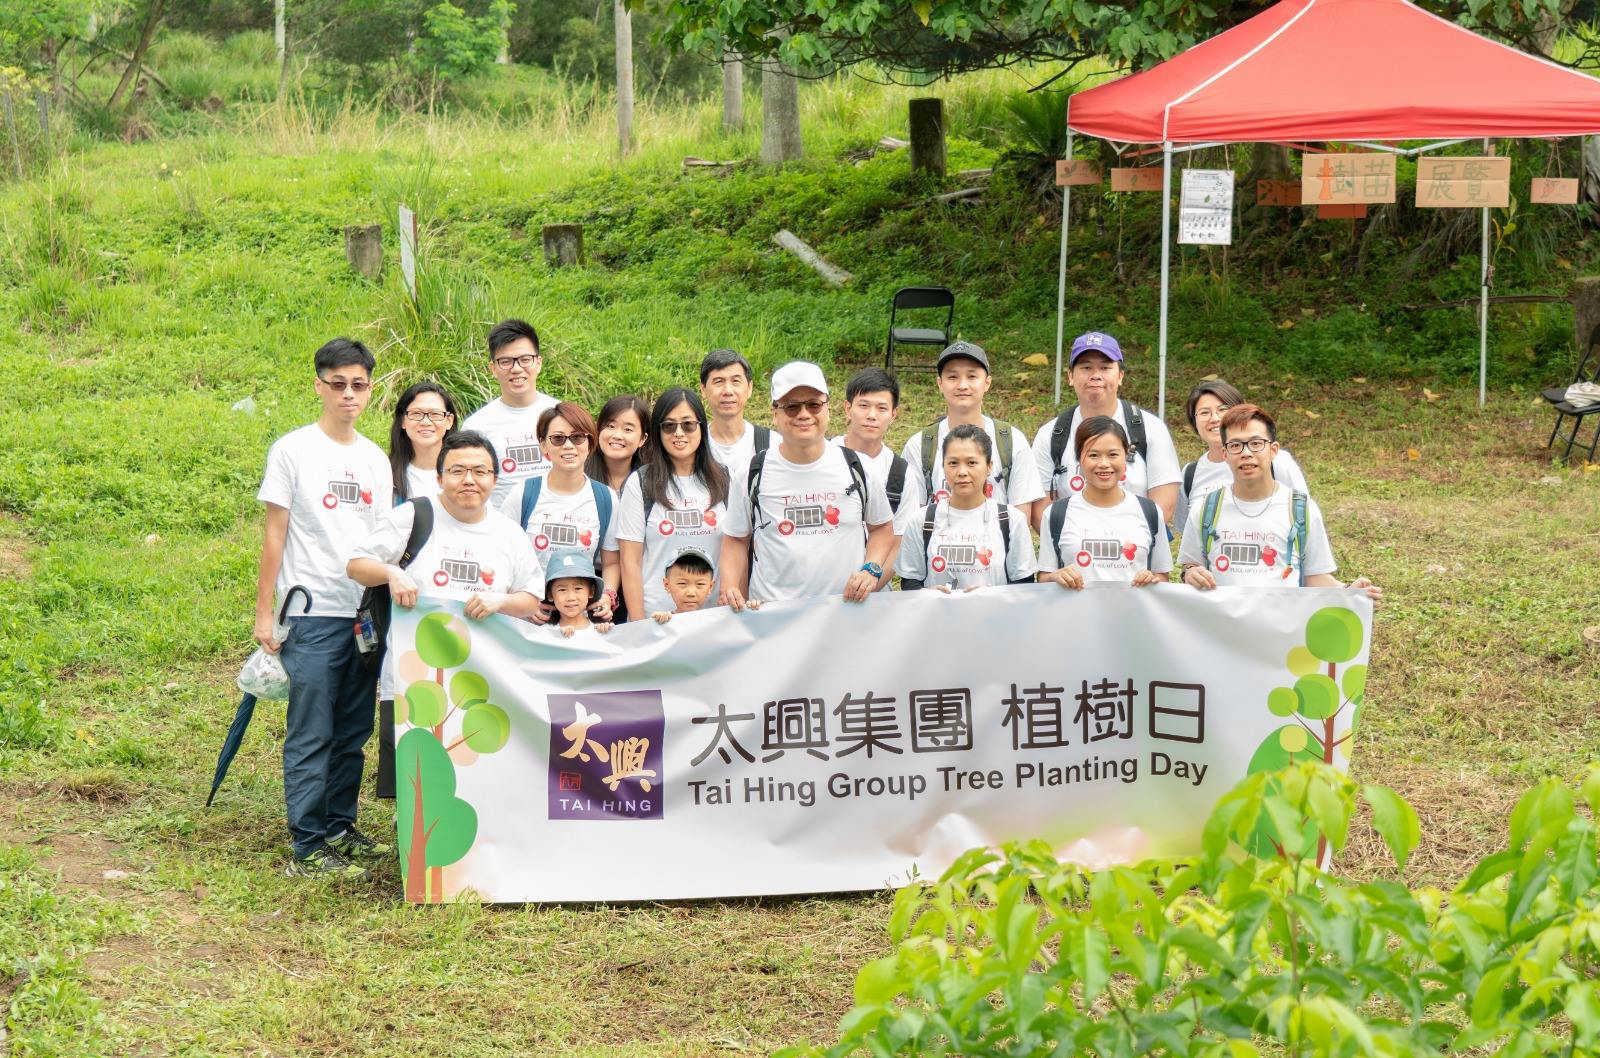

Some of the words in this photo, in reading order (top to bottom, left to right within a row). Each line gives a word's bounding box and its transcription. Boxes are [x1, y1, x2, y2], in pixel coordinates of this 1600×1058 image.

[781, 495, 802, 505] TAI
[805, 492, 836, 503] HING
[1222, 531, 1241, 540] TAI
[1245, 532, 1276, 542] HING
[691, 687, 974, 767] 太興集團
[1001, 677, 1206, 751] 植樹日
[559, 701, 657, 793] 太興
[687, 778, 731, 806] Tai
[743, 776, 816, 807] Hing
[827, 772, 927, 801] Group
[936, 766, 1004, 792] Tree
[1015, 756, 1138, 789] Planting
[1150, 751, 1209, 787] Day
[559, 798, 591, 811] TAI
[602, 799, 652, 812] HING
